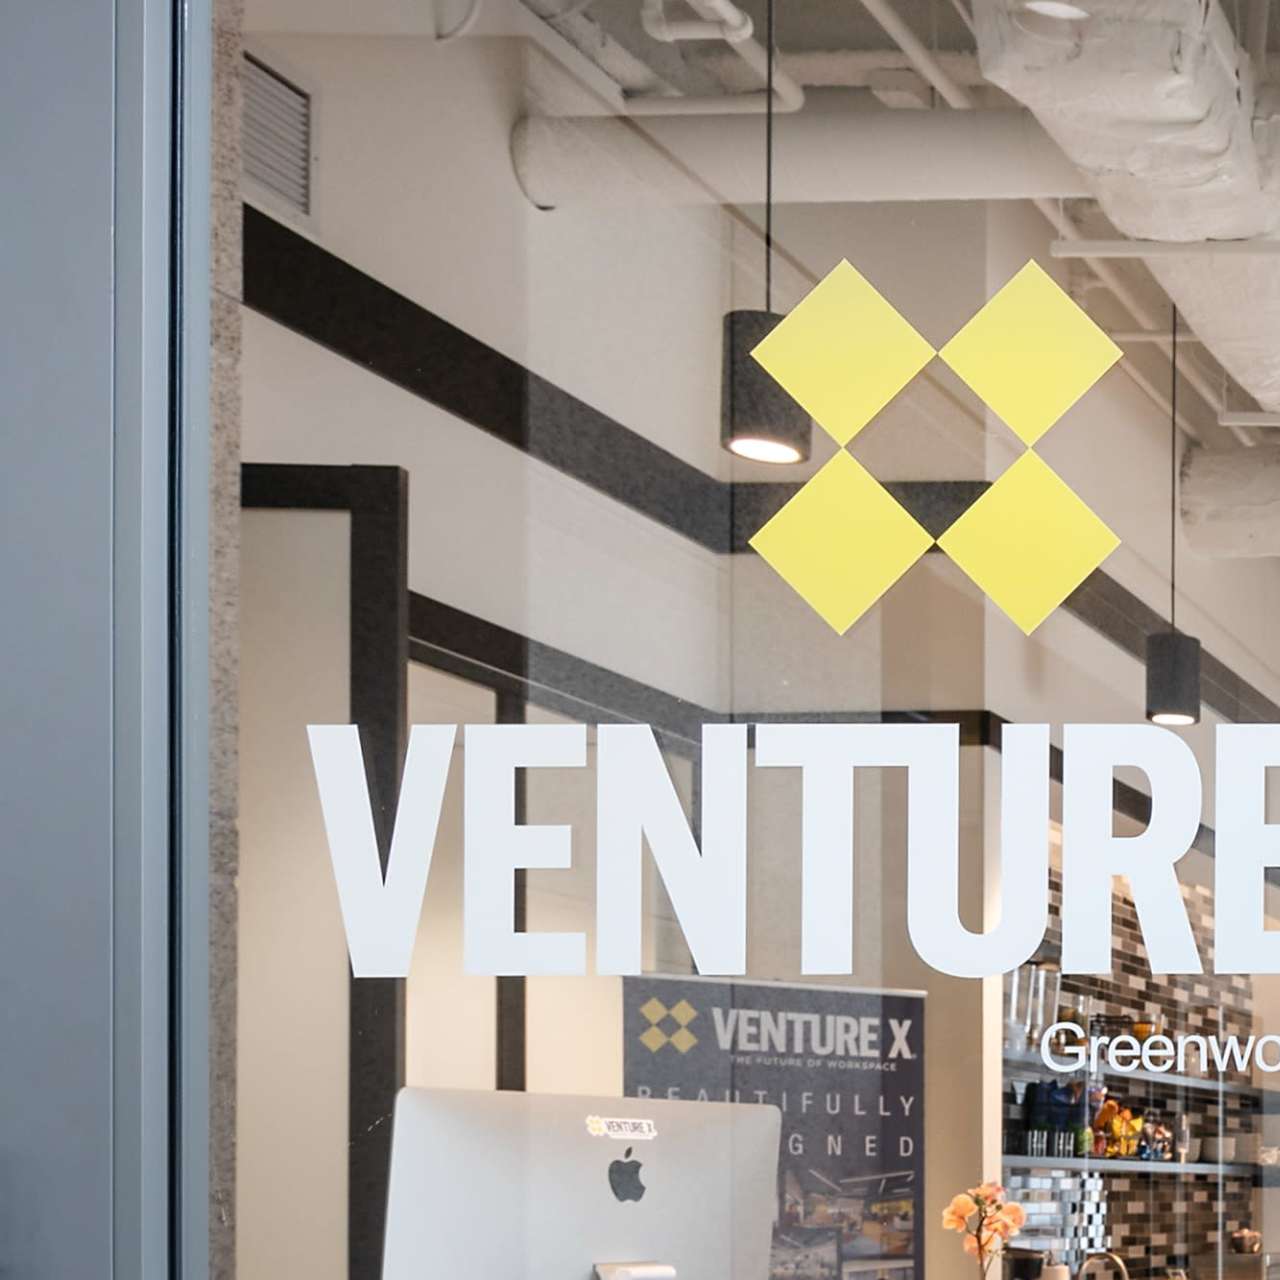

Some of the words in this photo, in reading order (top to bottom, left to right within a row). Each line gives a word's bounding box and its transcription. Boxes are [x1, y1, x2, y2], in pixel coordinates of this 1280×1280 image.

[712, 1006, 881, 1059] VENTURE
[888, 1018, 914, 1060] X
[756, 1057, 801, 1067] FUTURE
[807, 1058, 824, 1068] OF
[828, 1060, 897, 1072] WORKSPACE
